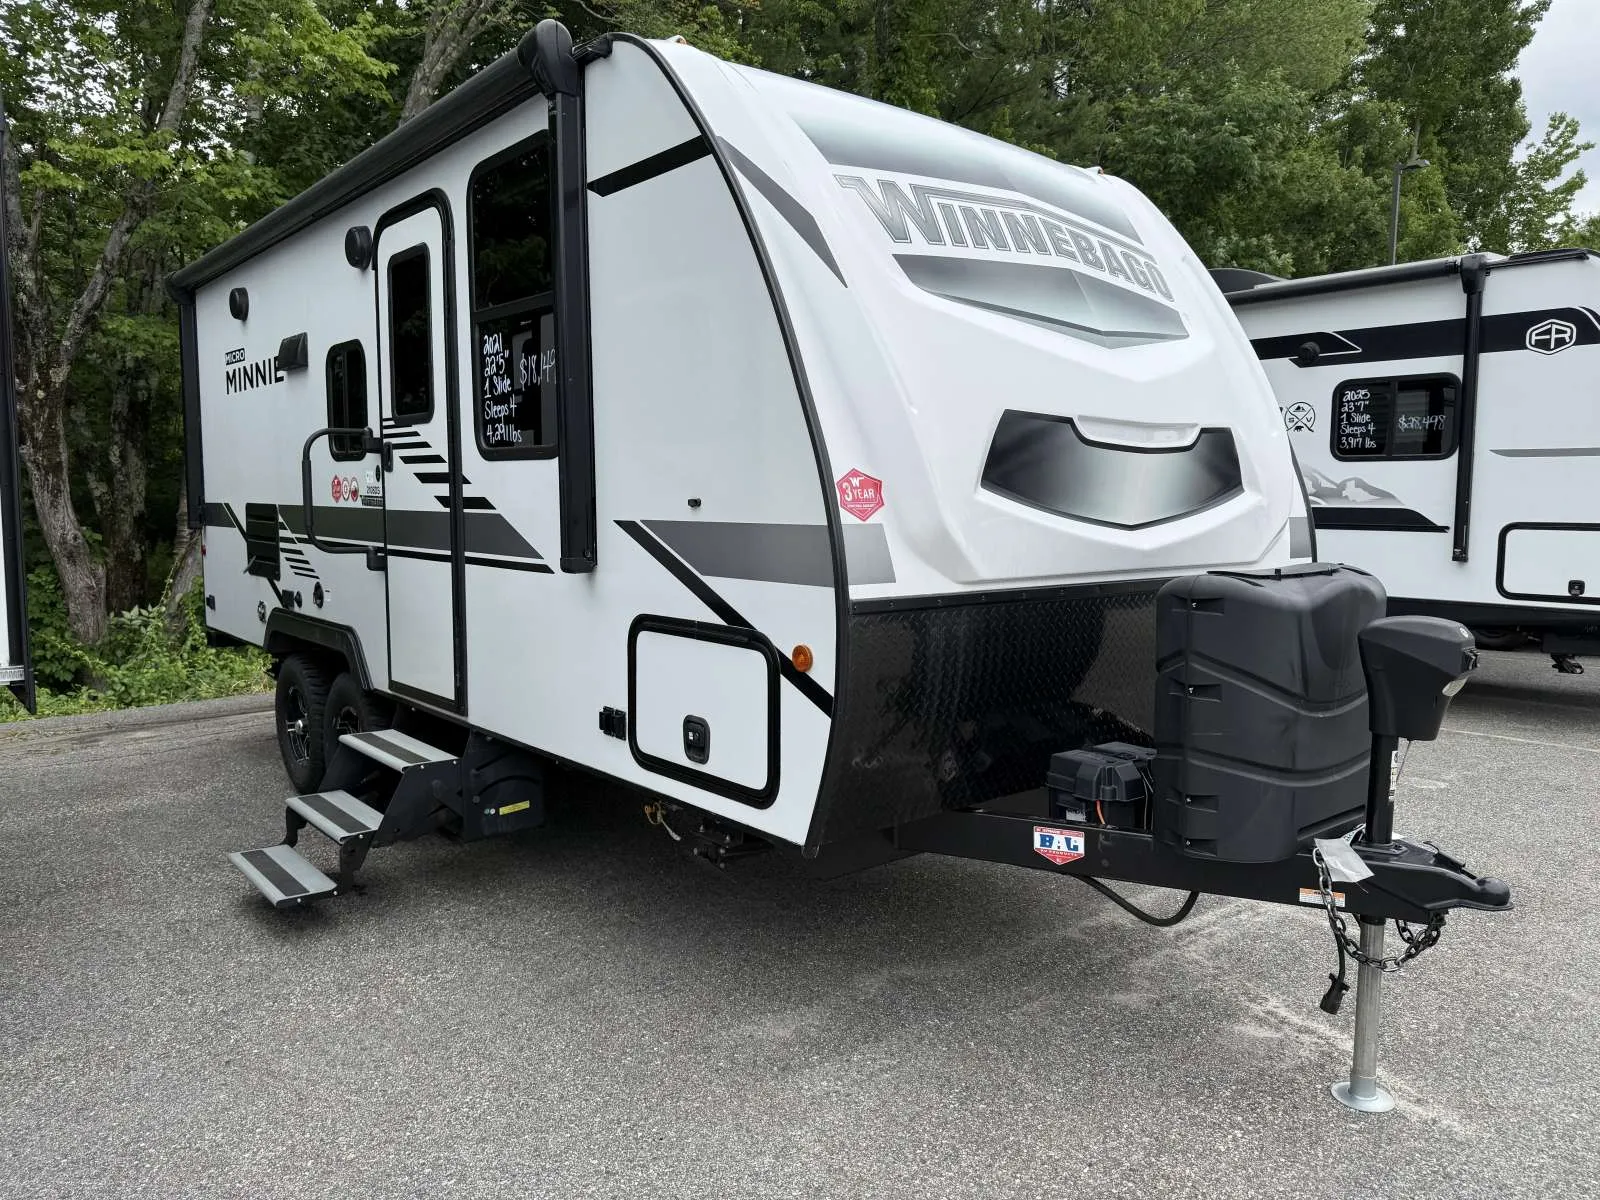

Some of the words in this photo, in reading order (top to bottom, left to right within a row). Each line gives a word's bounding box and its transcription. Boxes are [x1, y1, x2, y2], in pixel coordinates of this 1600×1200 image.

[834, 175, 1175, 303] WINNEBAGO
[483, 332, 503, 356] 2021
[225, 349, 246, 364] MICRO
[484, 378, 492, 399] 1
[493, 375, 512, 396] Slide
[1343, 389, 1371, 402] 2025
[484, 401, 509, 424] Sleeps
[510, 393, 518, 418] 4
[1340, 414, 1348, 425] 1
[1350, 412, 1371, 424] Slide
[1340, 424, 1367, 437] Sleeps
[1368, 423, 1376, 435] 4
[1365, 437, 1377, 448] lbs
[842, 481, 853, 502] 3
[852, 488, 875, 500] YEAR
